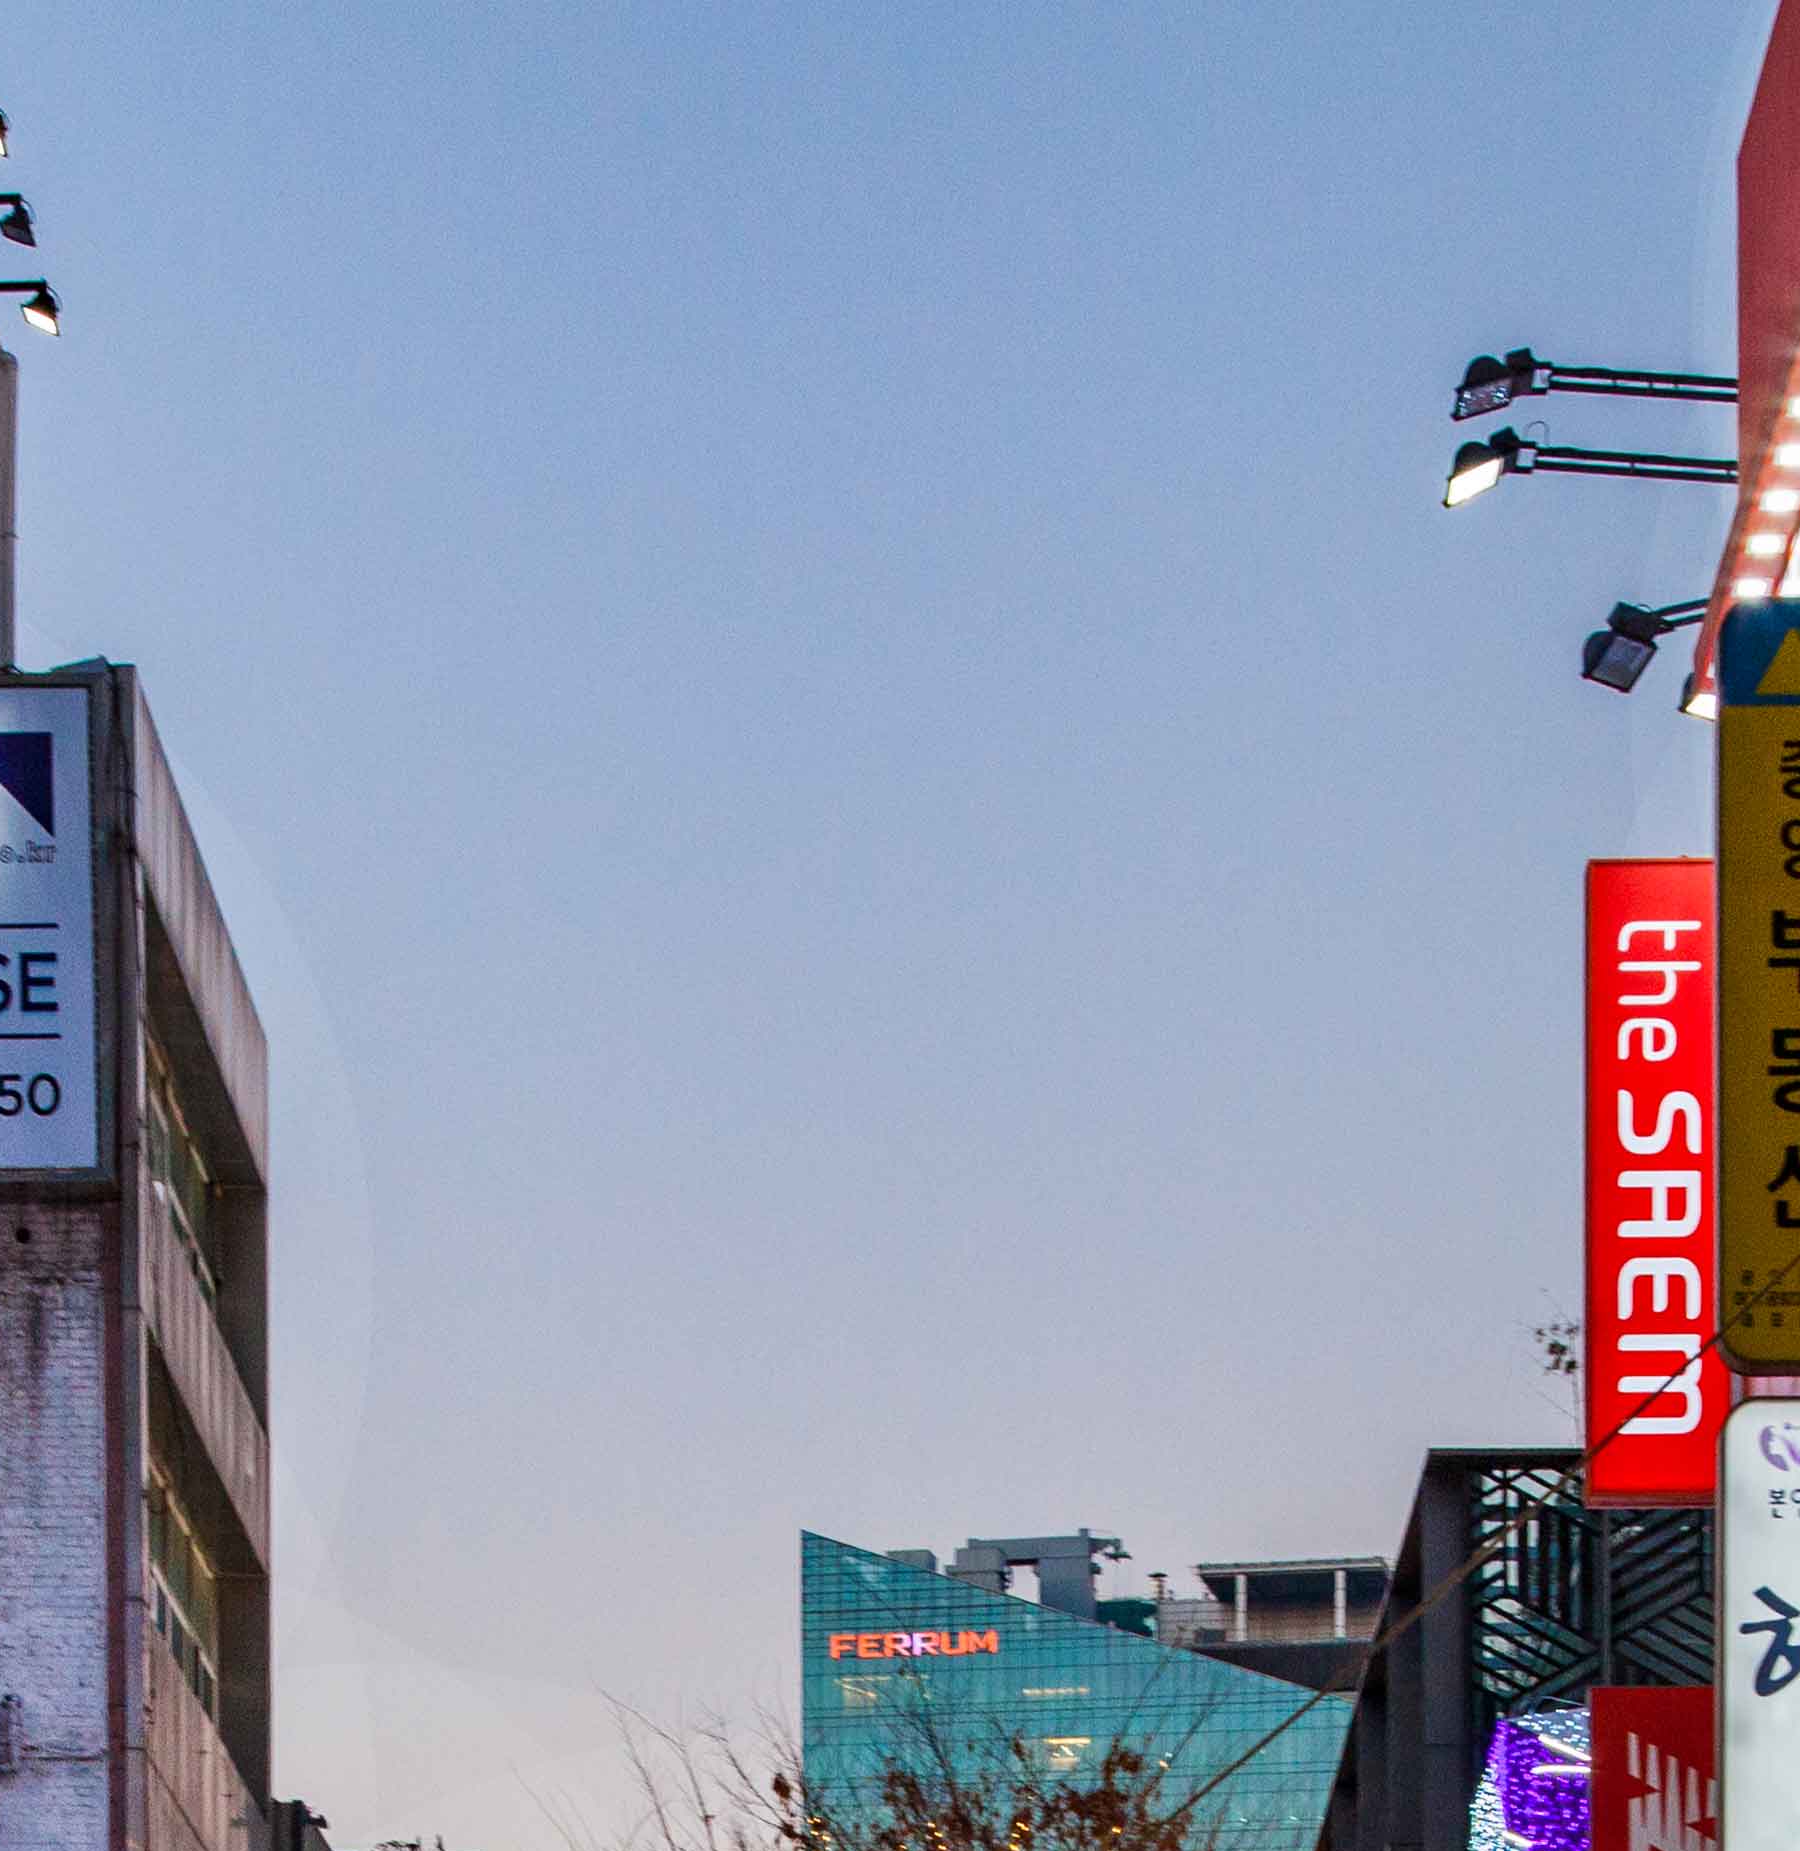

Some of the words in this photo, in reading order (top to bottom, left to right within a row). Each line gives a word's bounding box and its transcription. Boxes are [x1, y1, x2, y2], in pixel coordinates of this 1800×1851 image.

[1616, 920, 1701, 1062] the
[1616, 1088, 1703, 1436] SAEM
[829, 1629, 999, 1659] FERRUM
